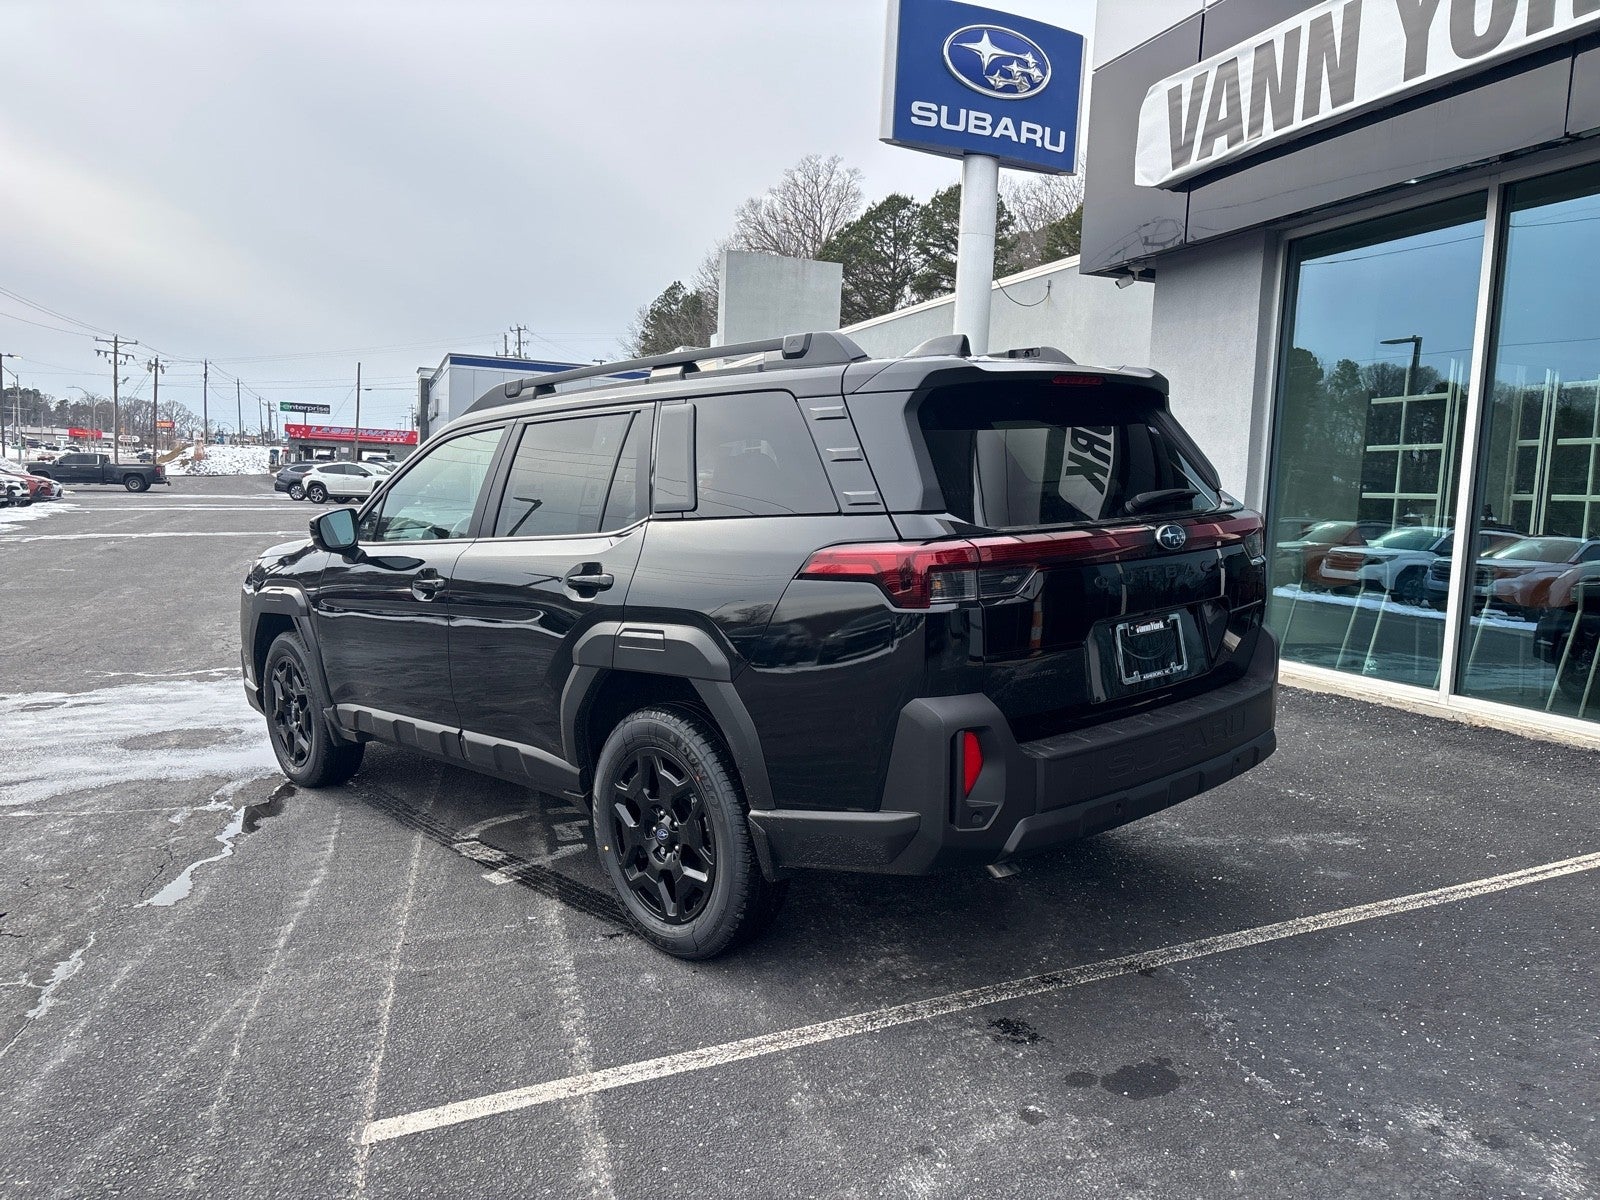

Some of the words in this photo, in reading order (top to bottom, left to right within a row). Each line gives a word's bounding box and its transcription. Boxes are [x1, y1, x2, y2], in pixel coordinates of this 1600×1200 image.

[1167, 0, 1362, 171] VANN
[1397, 0, 1600, 82] YO
[910, 100, 1066, 154] SUBARU
[282, 402, 330, 413] enterprise
[1107, 711, 1246, 780] SUBARU
